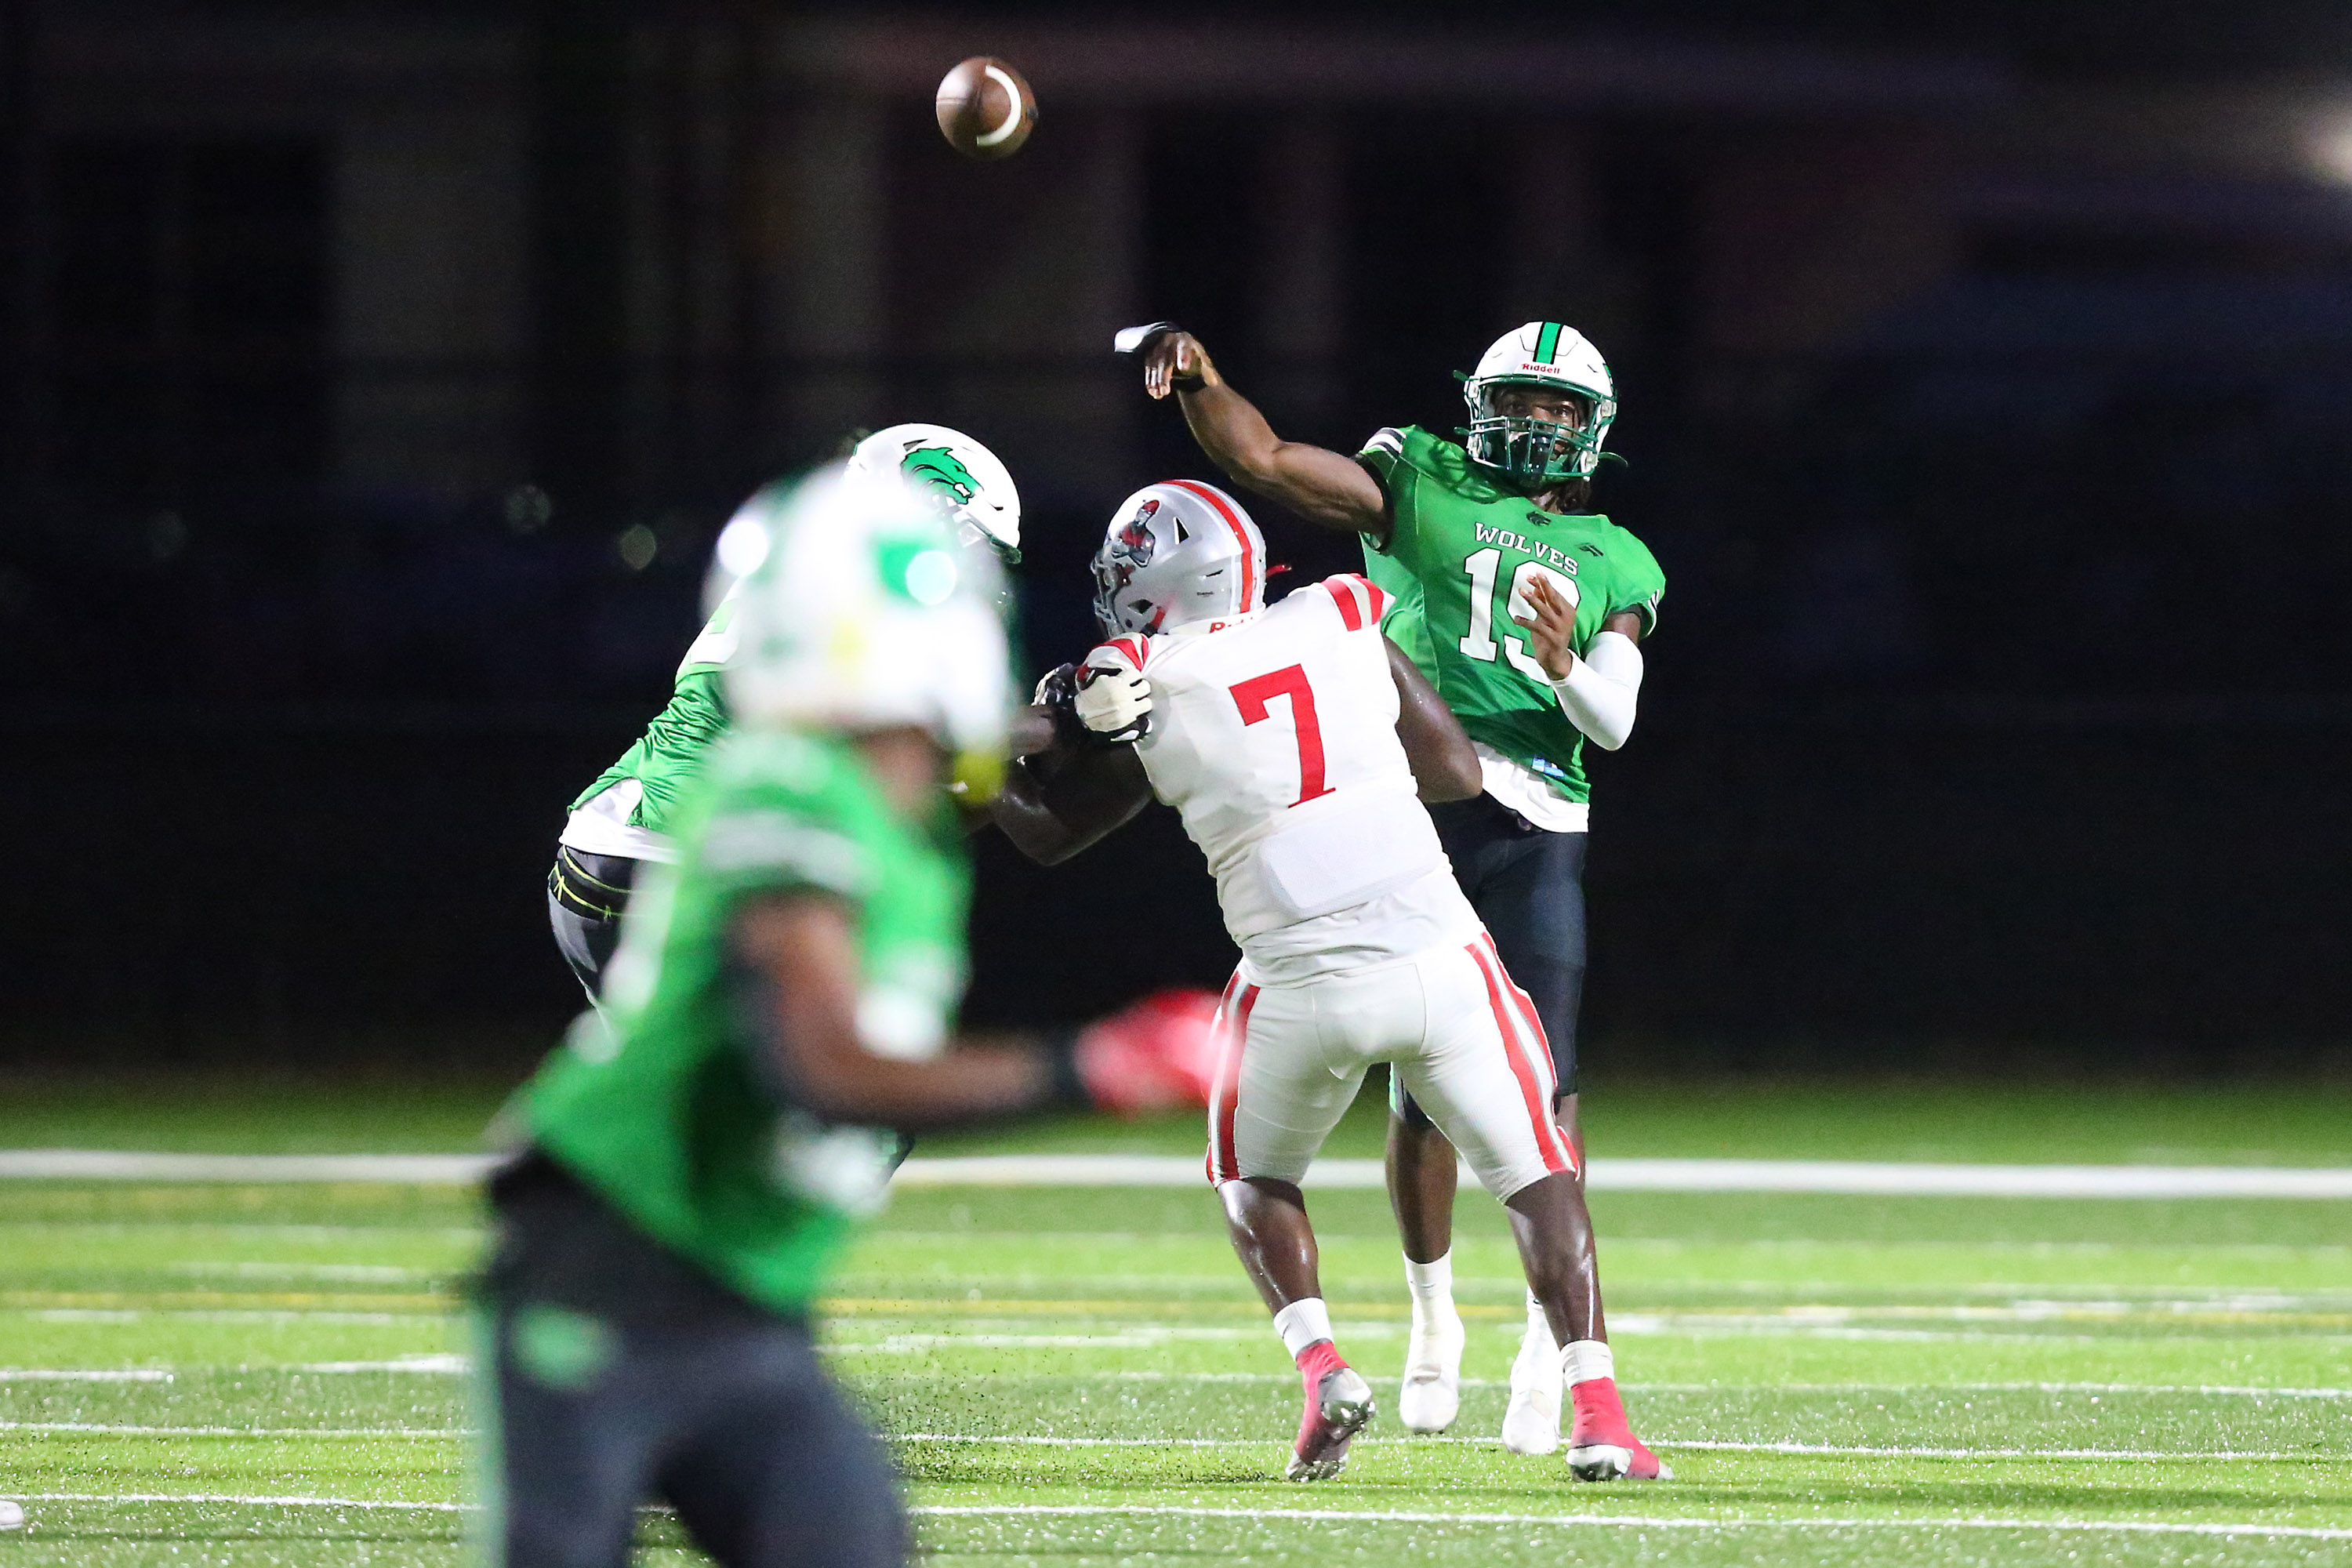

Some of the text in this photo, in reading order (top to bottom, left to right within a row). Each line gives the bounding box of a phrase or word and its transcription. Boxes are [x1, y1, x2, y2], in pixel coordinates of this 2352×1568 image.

[1522, 363, 1560, 375] Riddell
[1474, 521, 1579, 576] WOLVES
[1228, 662, 1337, 809] 7
